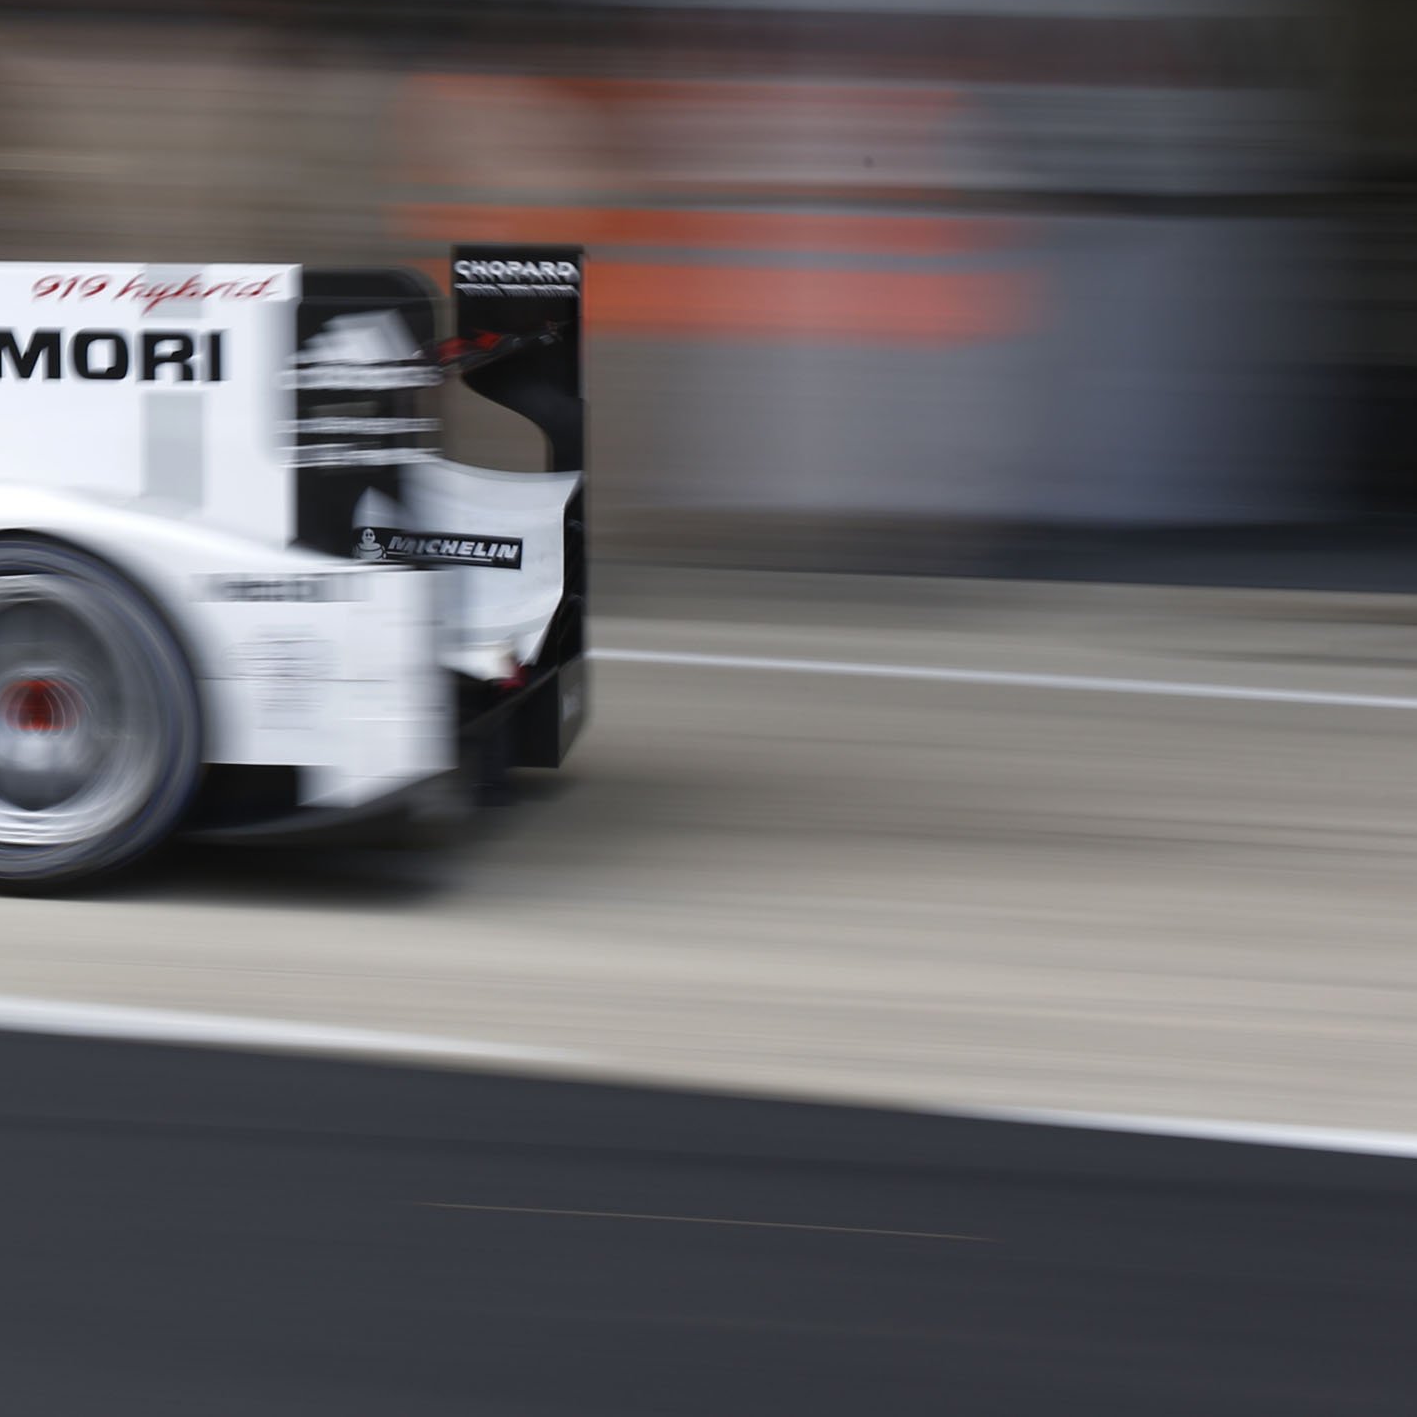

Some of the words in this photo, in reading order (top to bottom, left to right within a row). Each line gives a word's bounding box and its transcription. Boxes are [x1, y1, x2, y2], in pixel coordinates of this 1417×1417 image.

[454, 260, 580, 281] CHOPARD
[31, 273, 112, 300] 919
[113, 272, 284, 316] hybrid
[387, 536, 519, 560] MICHELIN
